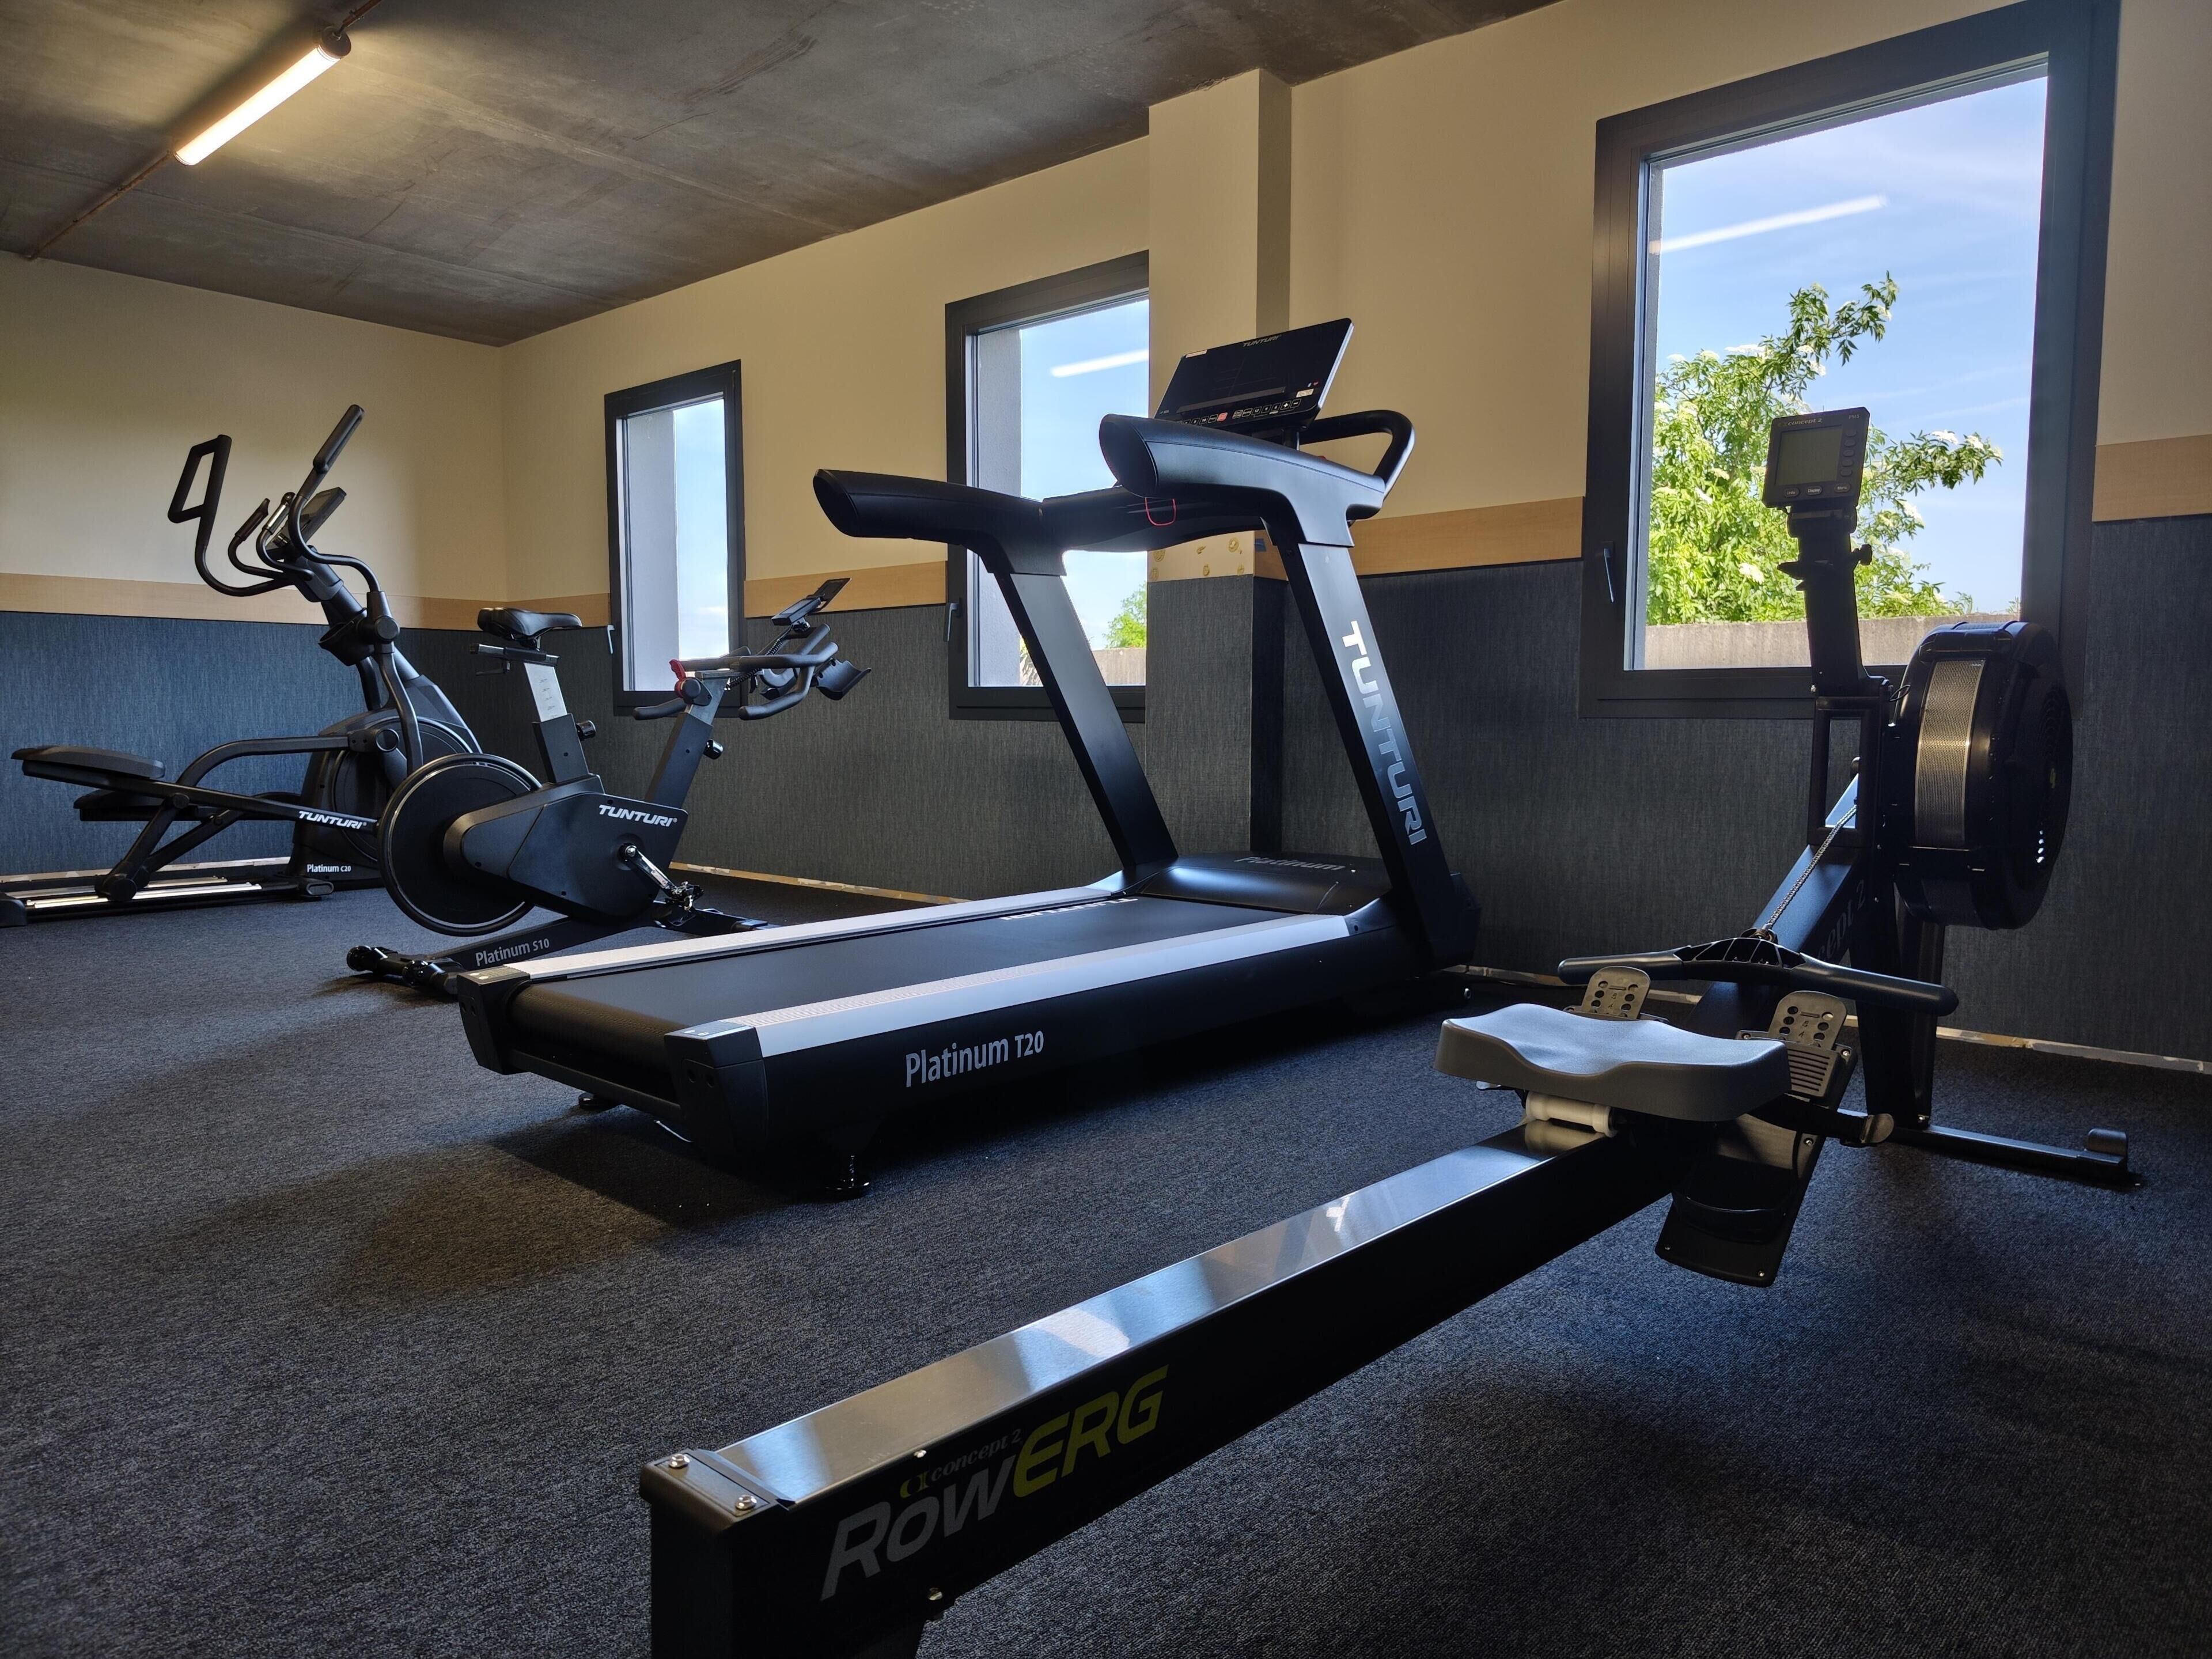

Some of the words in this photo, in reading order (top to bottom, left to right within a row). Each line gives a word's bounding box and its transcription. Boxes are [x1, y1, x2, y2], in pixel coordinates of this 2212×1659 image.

[1342, 620, 1427, 845] TUNTURI
[306, 864, 339, 873] Platinum
[1233, 857, 1346, 870] Platinum
[475, 943, 531, 967] Platinum
[532, 938, 550, 952] S10
[906, 1038, 1008, 1088] Platinum
[1014, 1030, 1044, 1058] T20
[931, 1434, 1009, 1482] concept
[1011, 1428, 1022, 1445] 2
